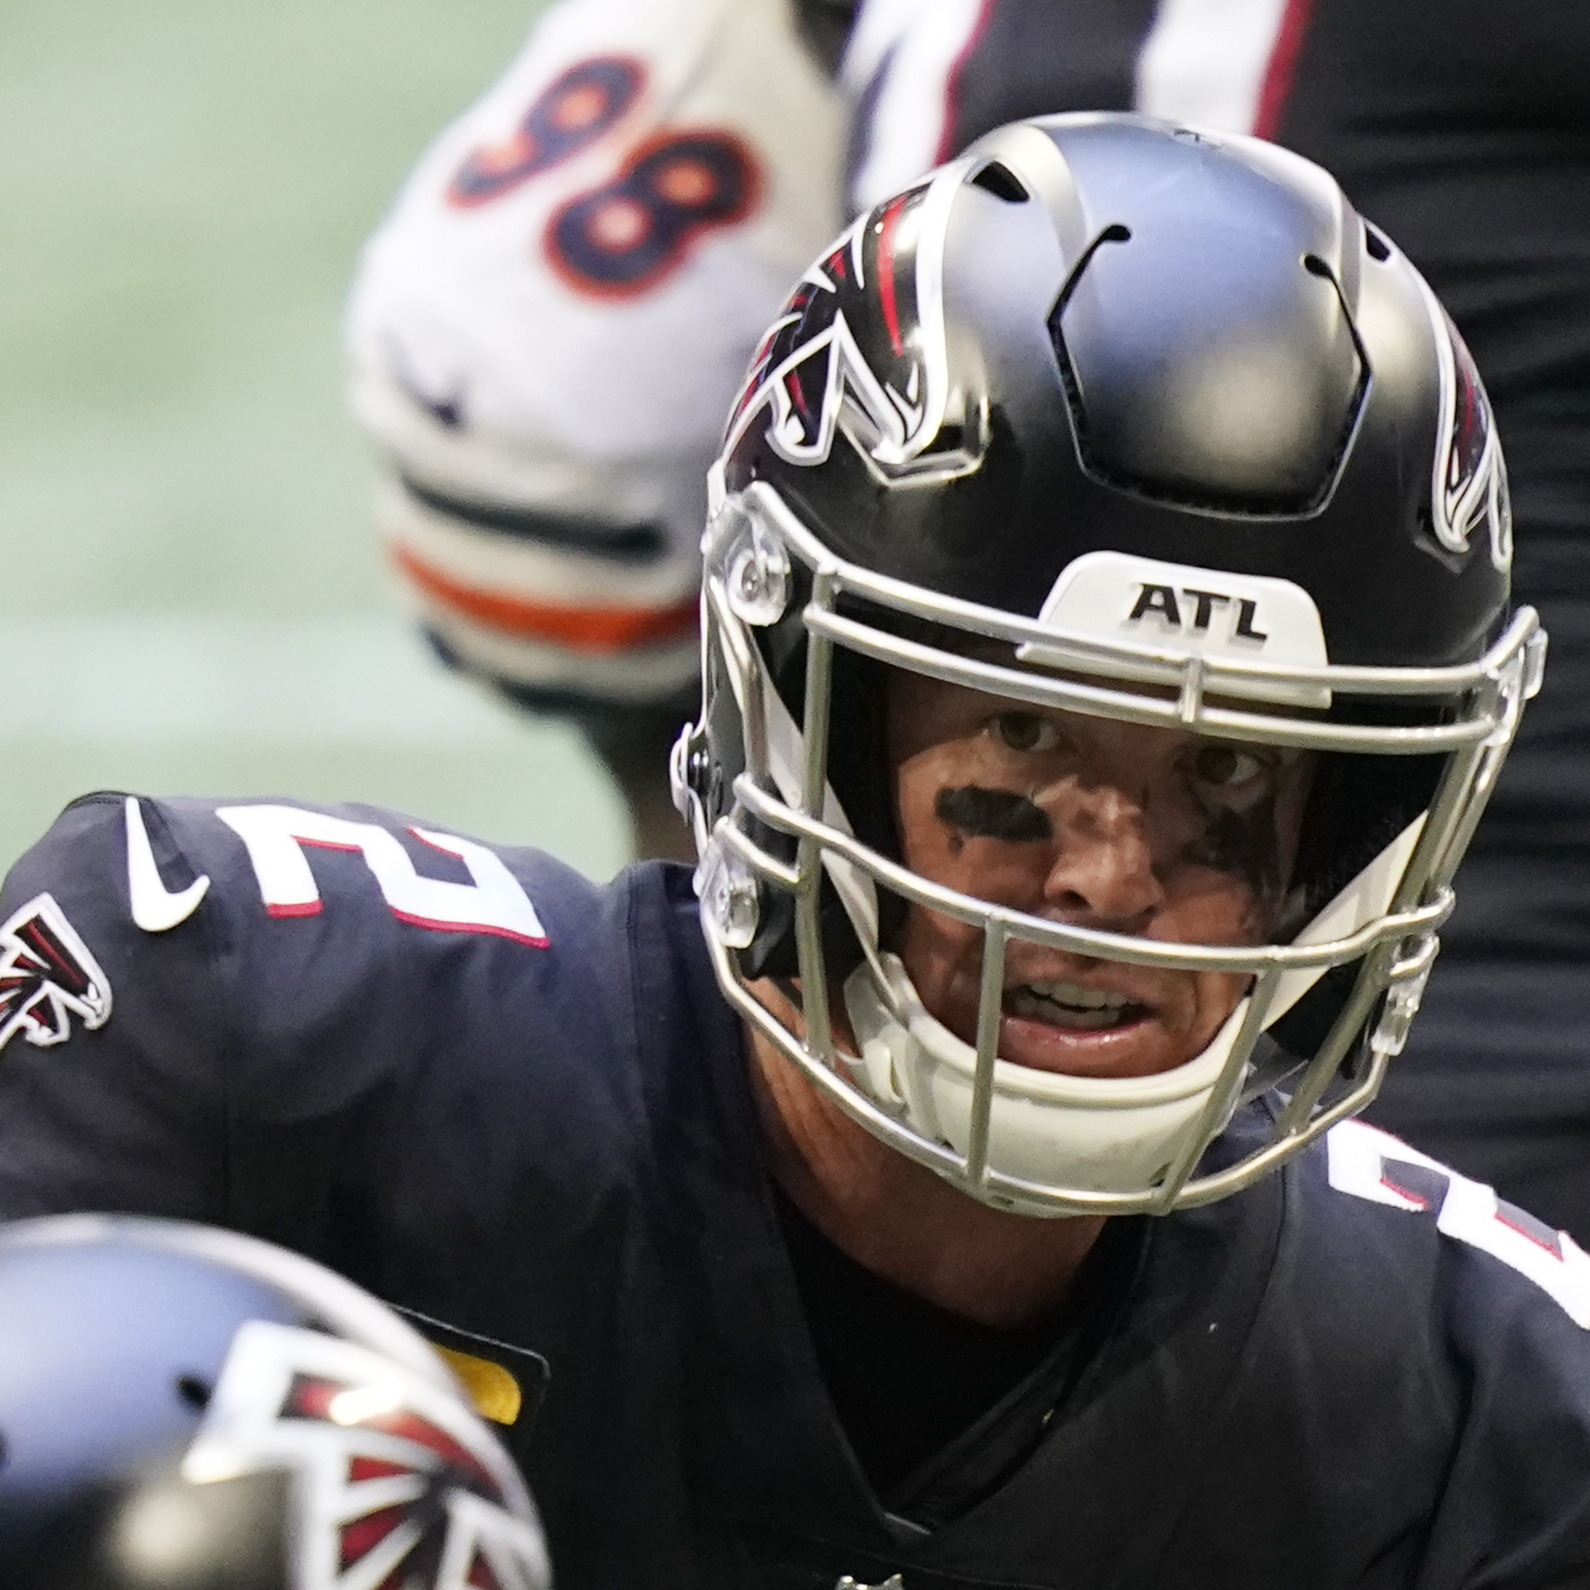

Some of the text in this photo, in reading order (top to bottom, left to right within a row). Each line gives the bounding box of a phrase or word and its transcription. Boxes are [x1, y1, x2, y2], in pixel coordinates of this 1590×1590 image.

[445, 50, 759, 302] 98
[1127, 582, 1268, 642] ATL
[215, 804, 551, 948] 2
